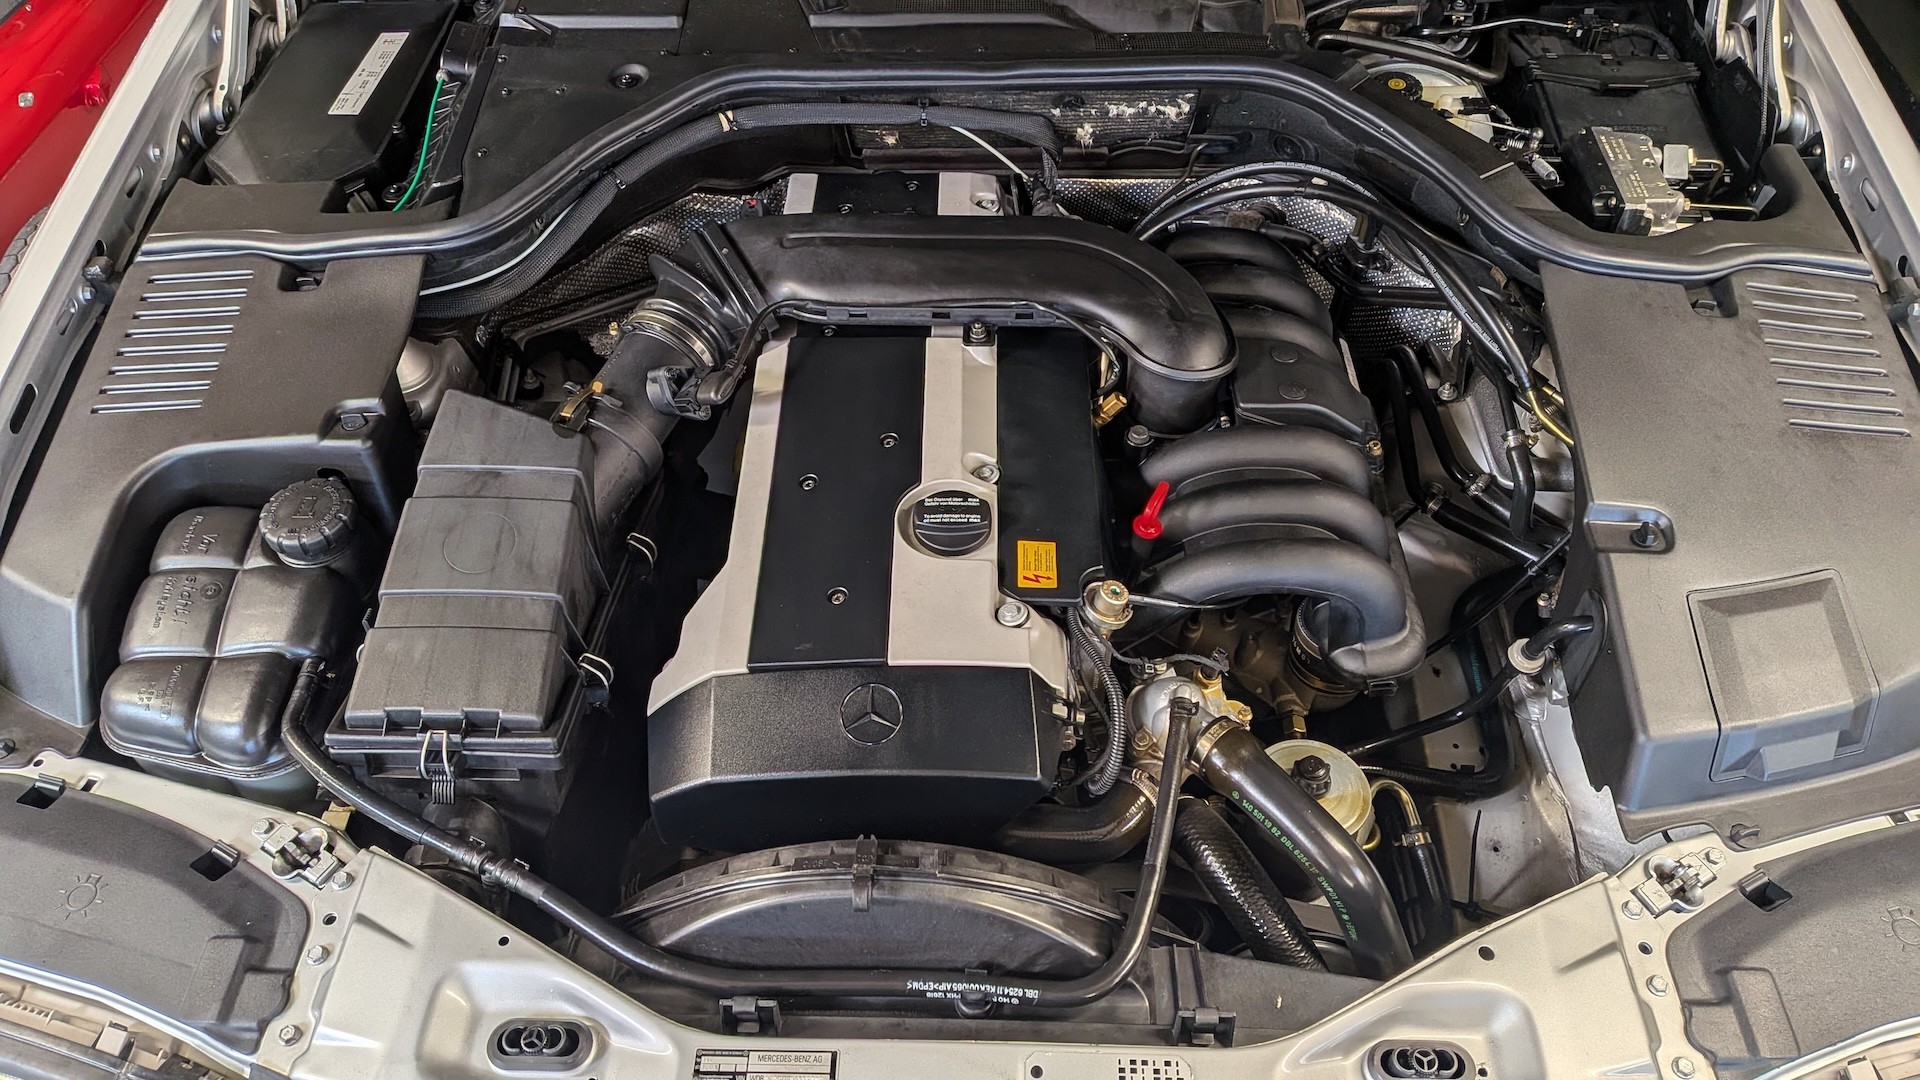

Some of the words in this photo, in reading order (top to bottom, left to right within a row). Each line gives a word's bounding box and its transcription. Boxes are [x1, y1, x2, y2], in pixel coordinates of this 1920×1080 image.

[1024, 988, 1039, 998] DBL
[757, 1054, 811, 1063] MERCEDES-BENZ
[812, 1055, 823, 1064] AG
